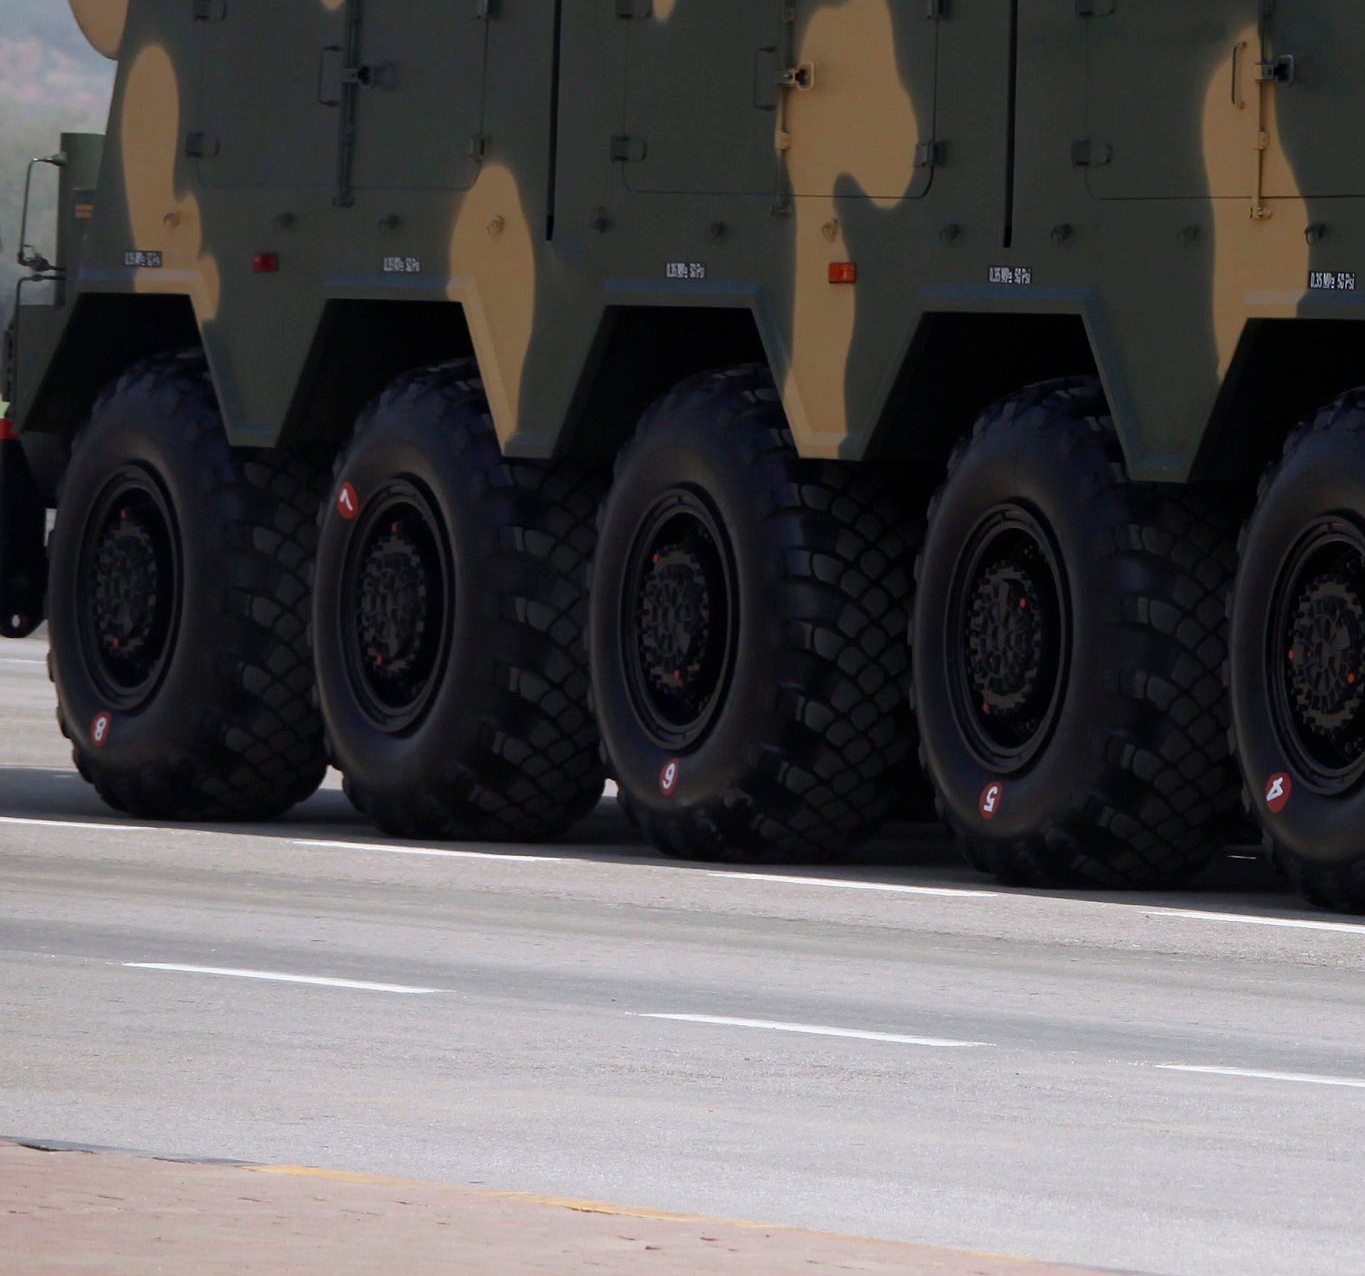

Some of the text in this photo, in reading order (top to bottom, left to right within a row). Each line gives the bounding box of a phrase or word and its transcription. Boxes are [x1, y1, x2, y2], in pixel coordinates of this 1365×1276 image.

[96, 717, 107, 741] 8
[984, 786, 998, 812] 5
[1266, 777, 1283, 802] 4
